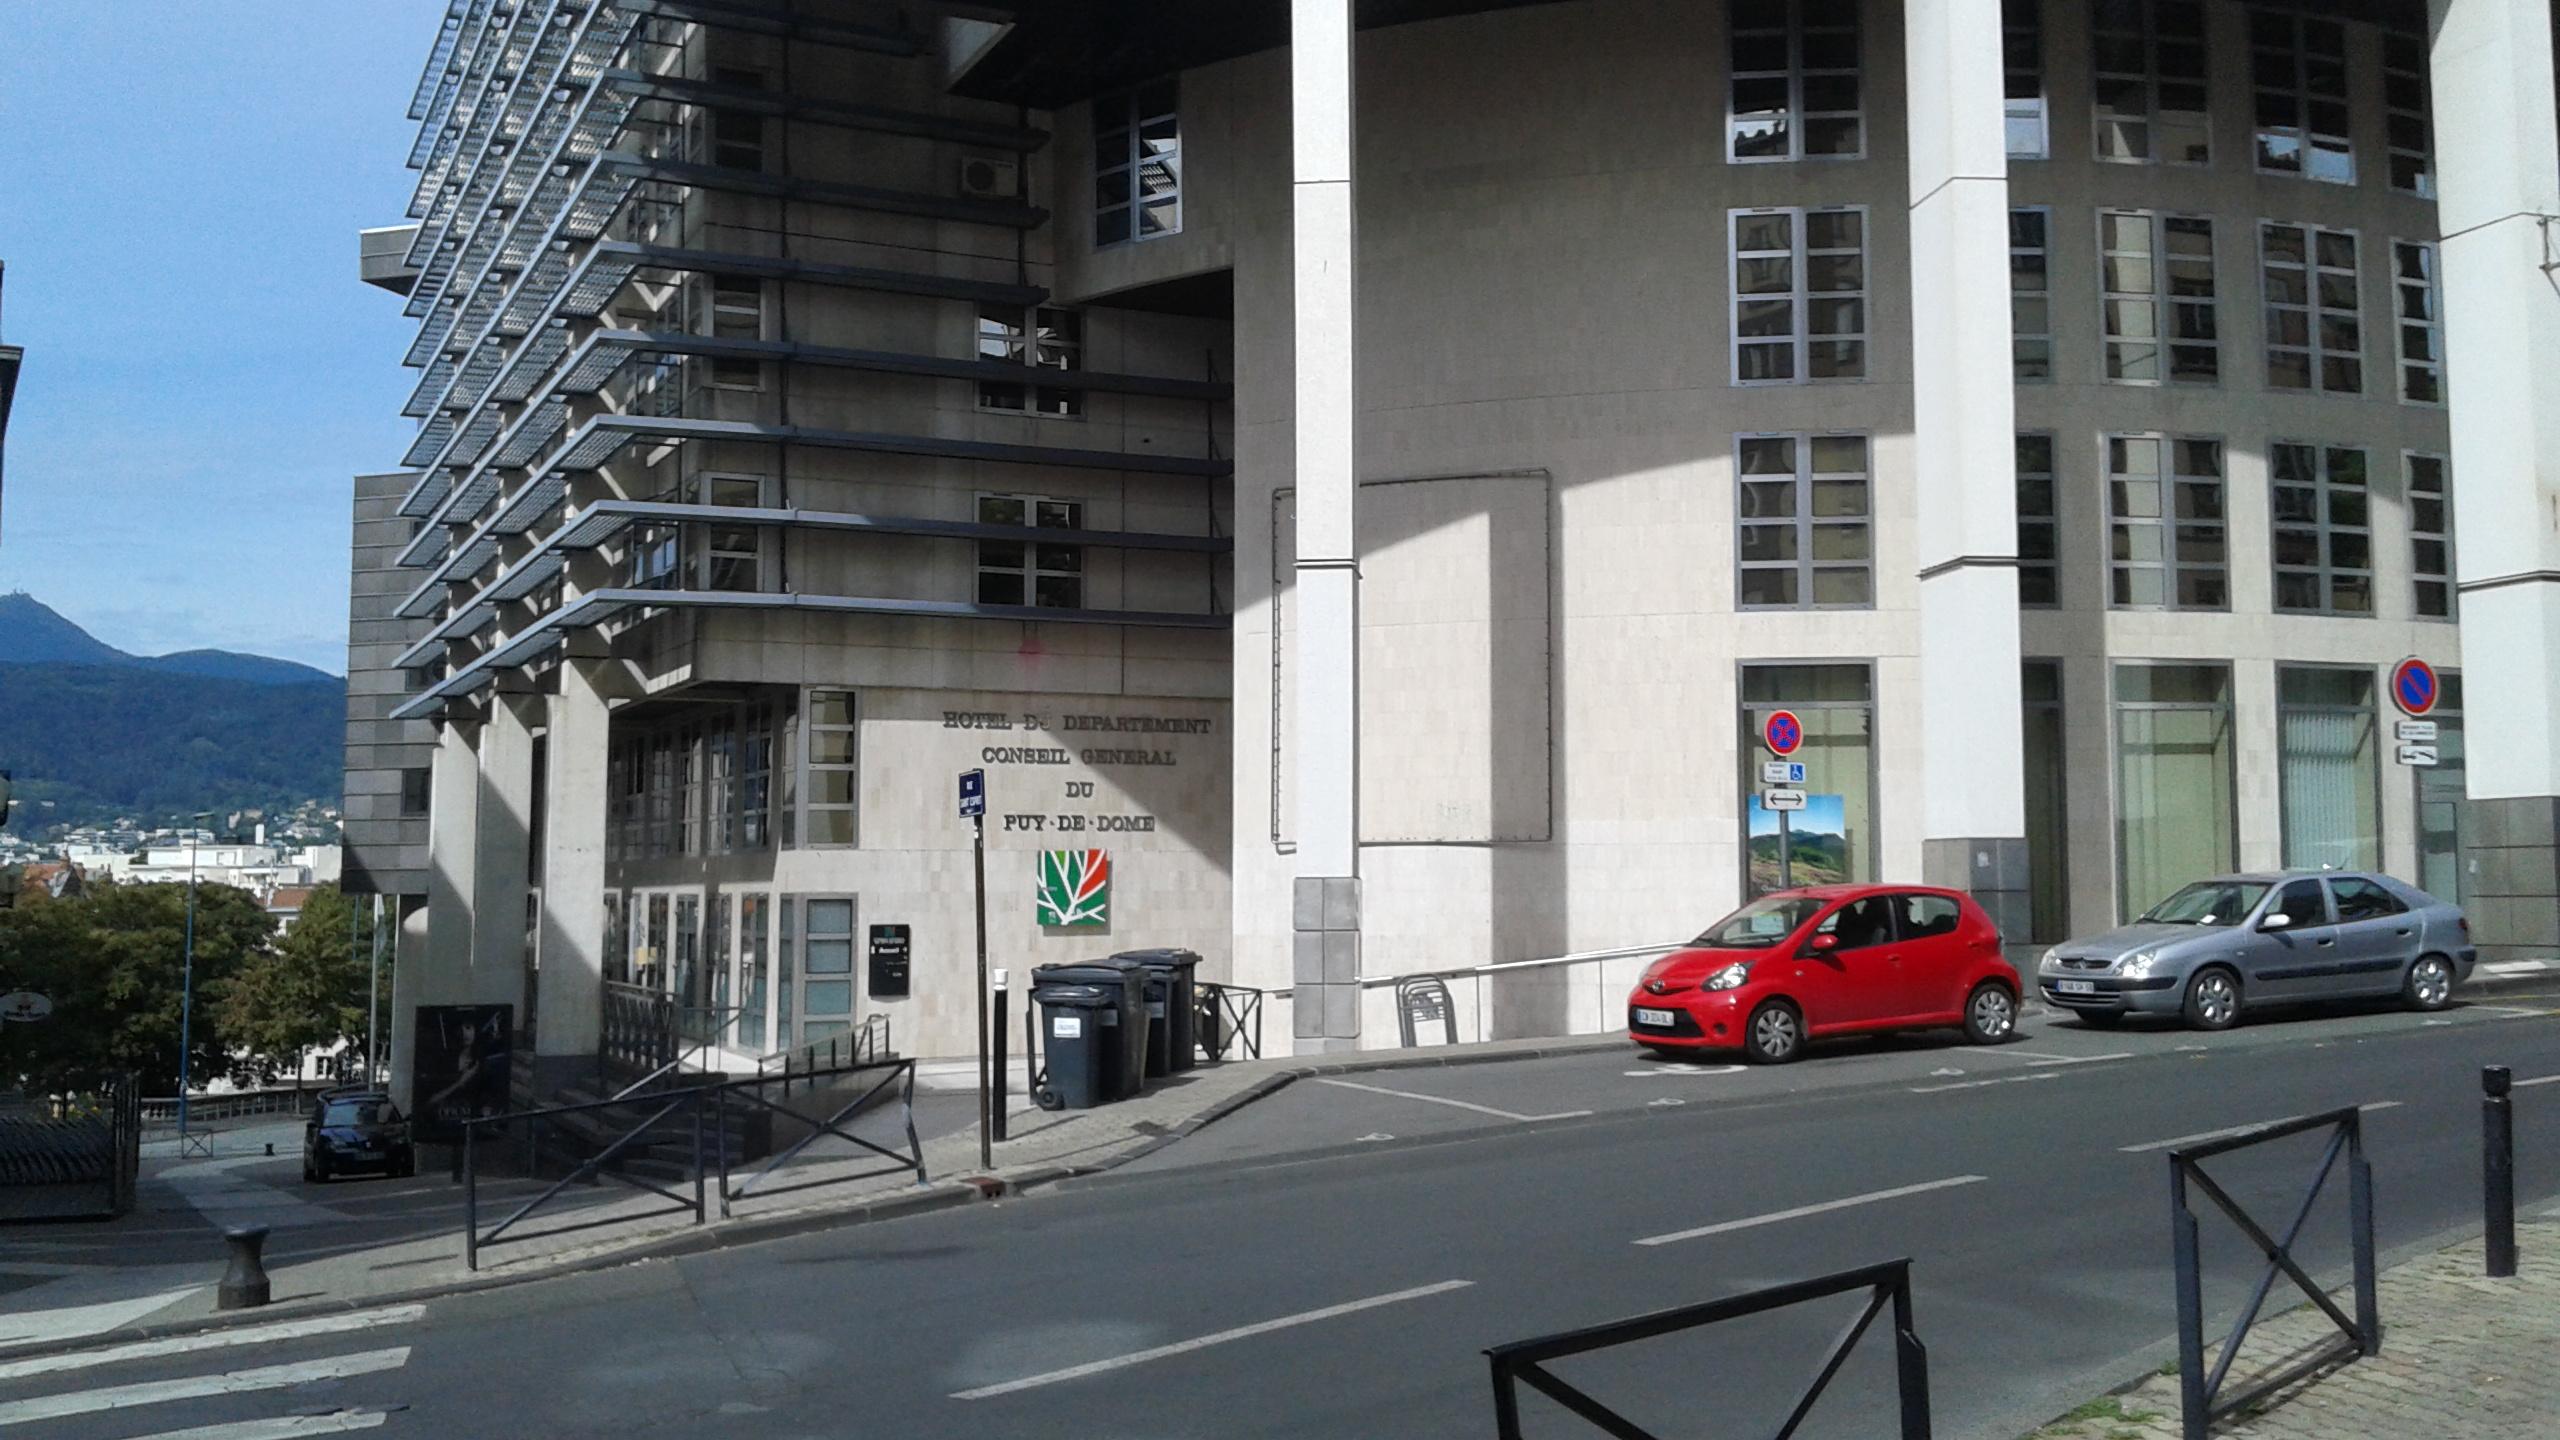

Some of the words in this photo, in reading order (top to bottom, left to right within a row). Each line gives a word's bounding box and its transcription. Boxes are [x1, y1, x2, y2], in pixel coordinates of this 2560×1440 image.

[943, 711, 1013, 730] HOTEL
[1063, 715, 1211, 734] DEPARTEMENT
[981, 747, 1070, 765] CONSEIL
[1081, 749, 1176, 766] GENERAL
[1065, 781, 1095, 798] DU
